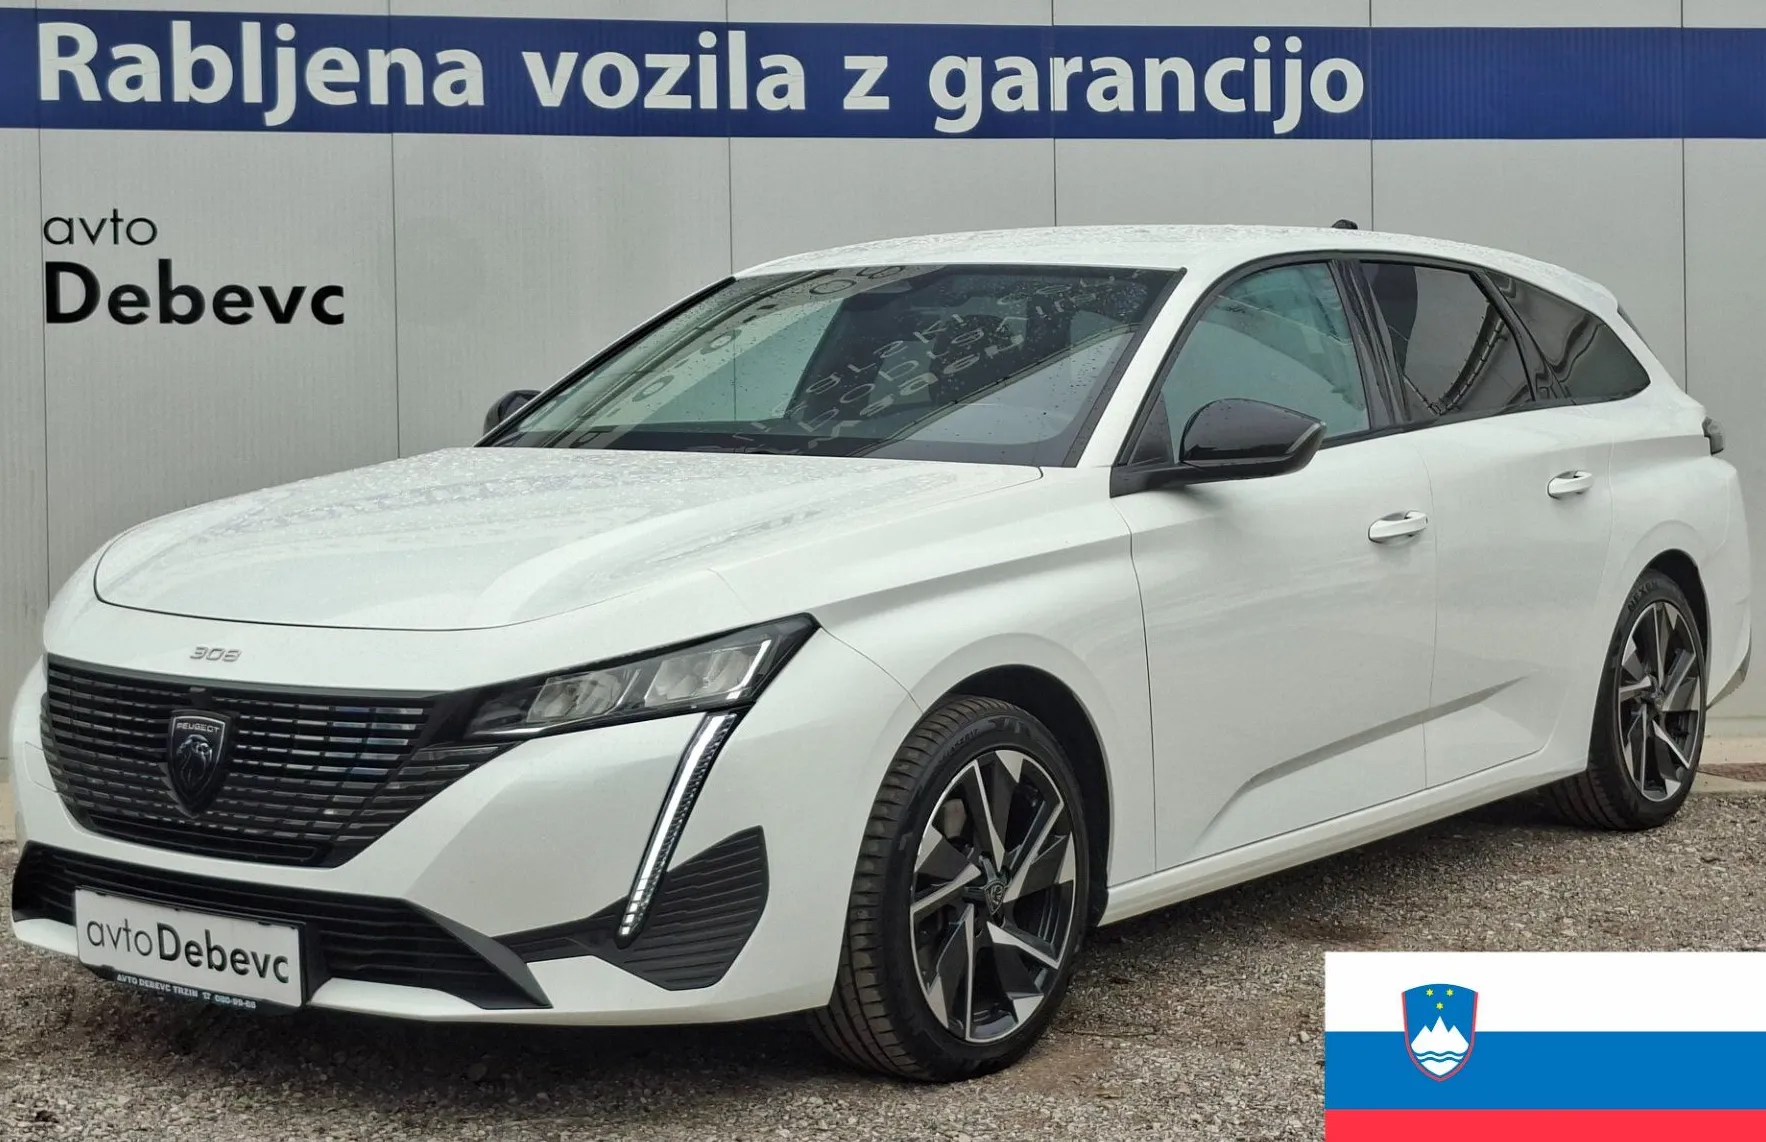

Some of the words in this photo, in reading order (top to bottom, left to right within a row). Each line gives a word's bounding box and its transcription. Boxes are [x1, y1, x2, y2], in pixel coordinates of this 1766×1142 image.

[38, 20, 485, 126] Rabljena
[522, 30, 806, 111] vozila
[843, 56, 890, 111] z
[928, 35, 1364, 134] garancijo
[43, 207, 157, 246] avto
[45, 258, 344, 325] Debevc
[189, 646, 242, 662] 308
[176, 721, 221, 733] PEUGEOT
[86, 918, 290, 984] avtoDebevc
[117, 974, 139, 985] AVTO
